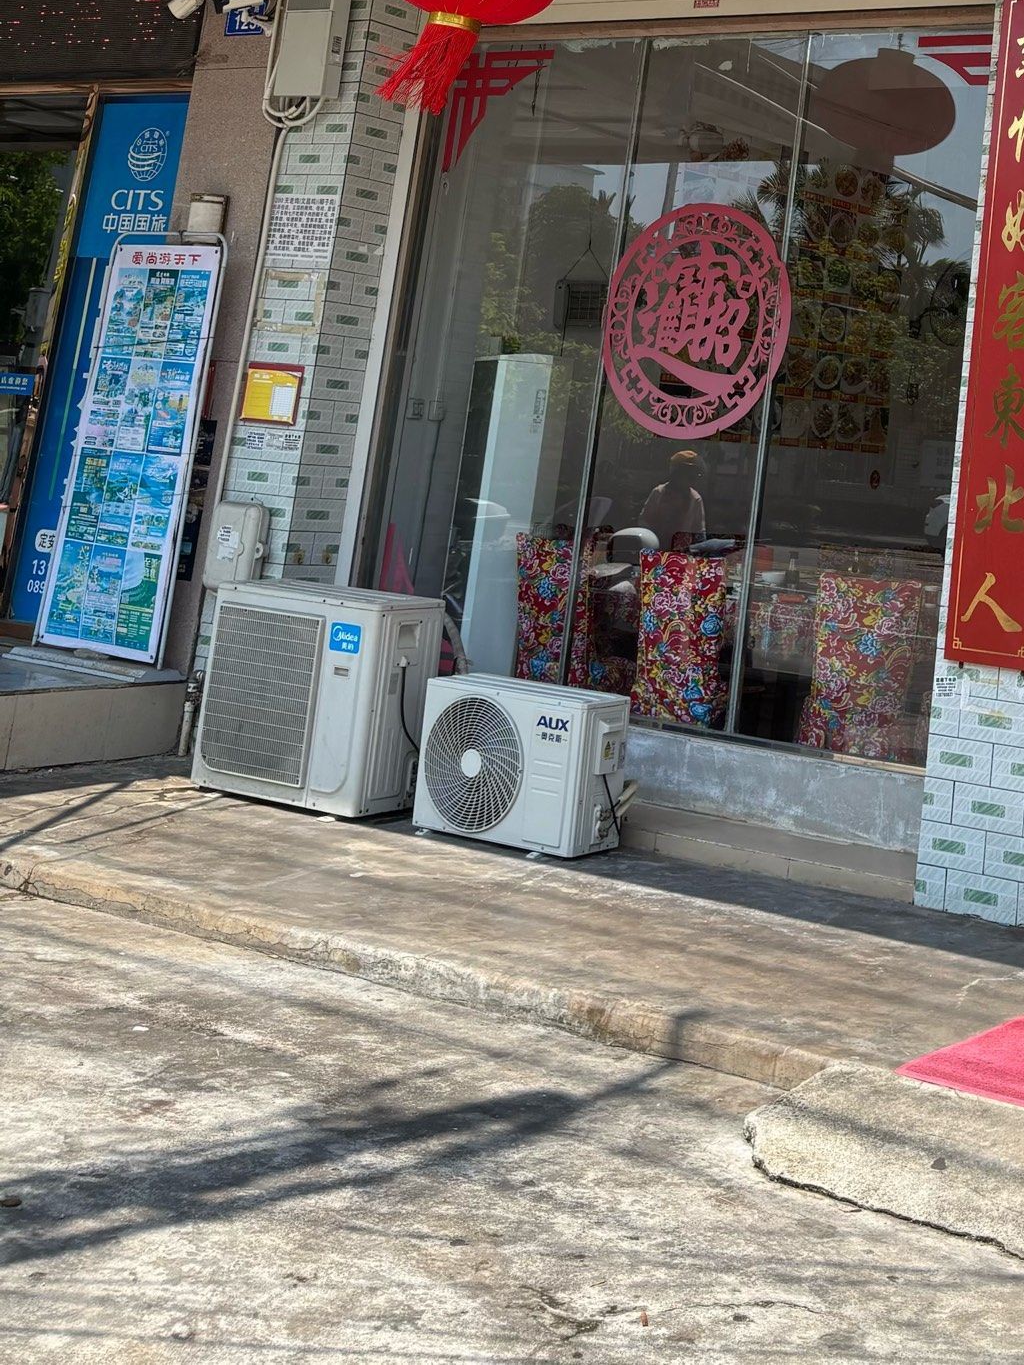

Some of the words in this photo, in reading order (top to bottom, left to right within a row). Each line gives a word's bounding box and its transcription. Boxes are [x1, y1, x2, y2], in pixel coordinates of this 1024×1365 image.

[140, 144, 158, 153] CITS
[111, 189, 164, 211] CITS
[102, 212, 167, 234] 中国国旅
[131, 251, 202, 266] 爱尚游天下
[32, 559, 49, 576] 13
[332, 625, 358, 643] Midea
[341, 642, 354, 651] 美的
[536, 715, 570, 732] AUX
[541, 731, 562, 744] 奥克斯
